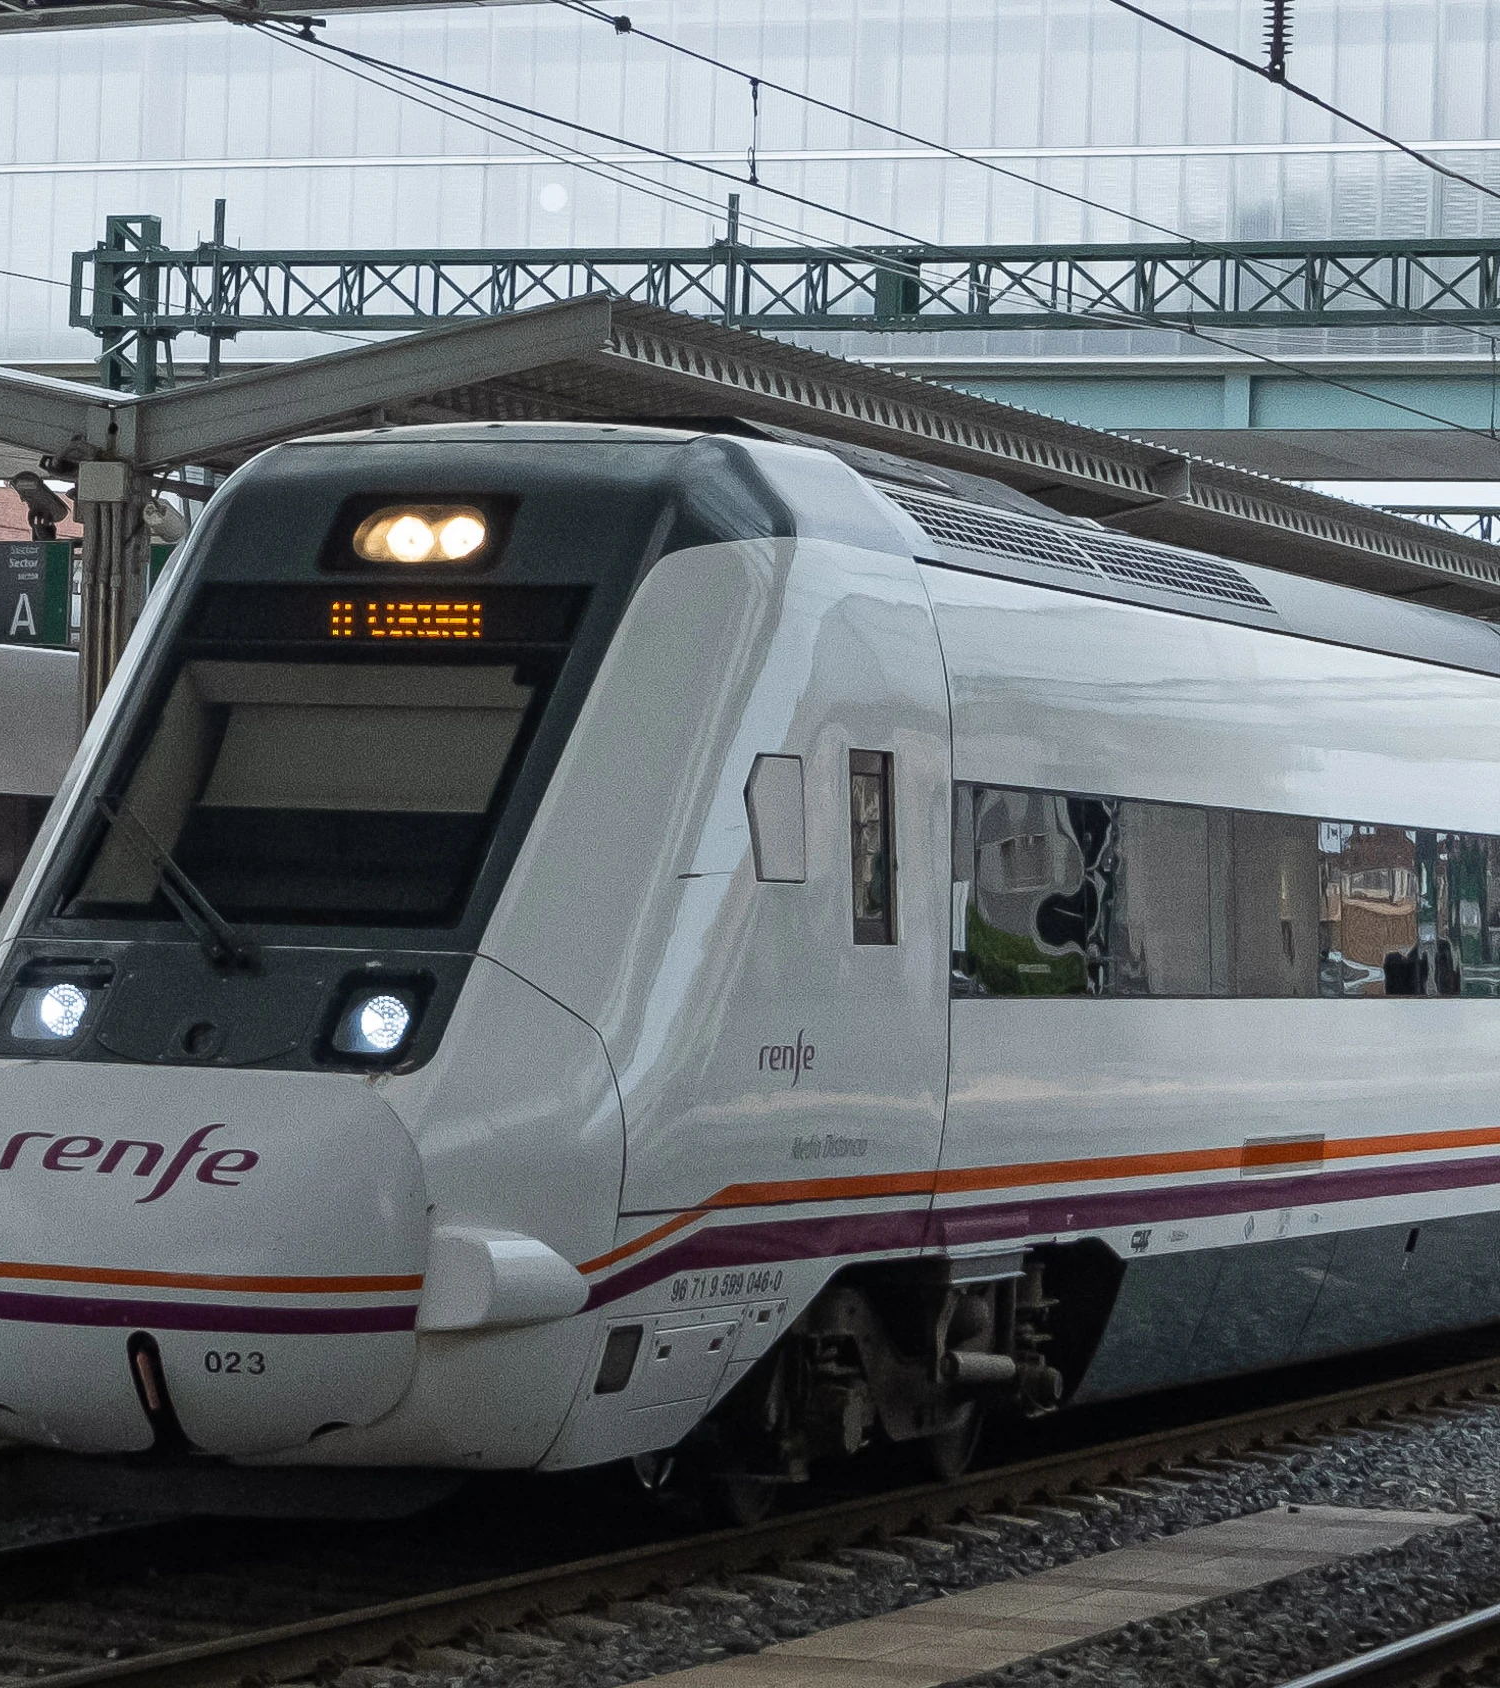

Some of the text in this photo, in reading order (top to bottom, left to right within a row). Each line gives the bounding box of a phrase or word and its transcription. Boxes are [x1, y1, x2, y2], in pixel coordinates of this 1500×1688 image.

[9, 558, 39, 568] Sector
[9, 593, 36, 635] A
[758, 1027, 816, 1088] renfe
[690, 1276, 706, 1299] 71
[709, 1275, 719, 1298] 9
[204, 1351, 266, 1375] 023
